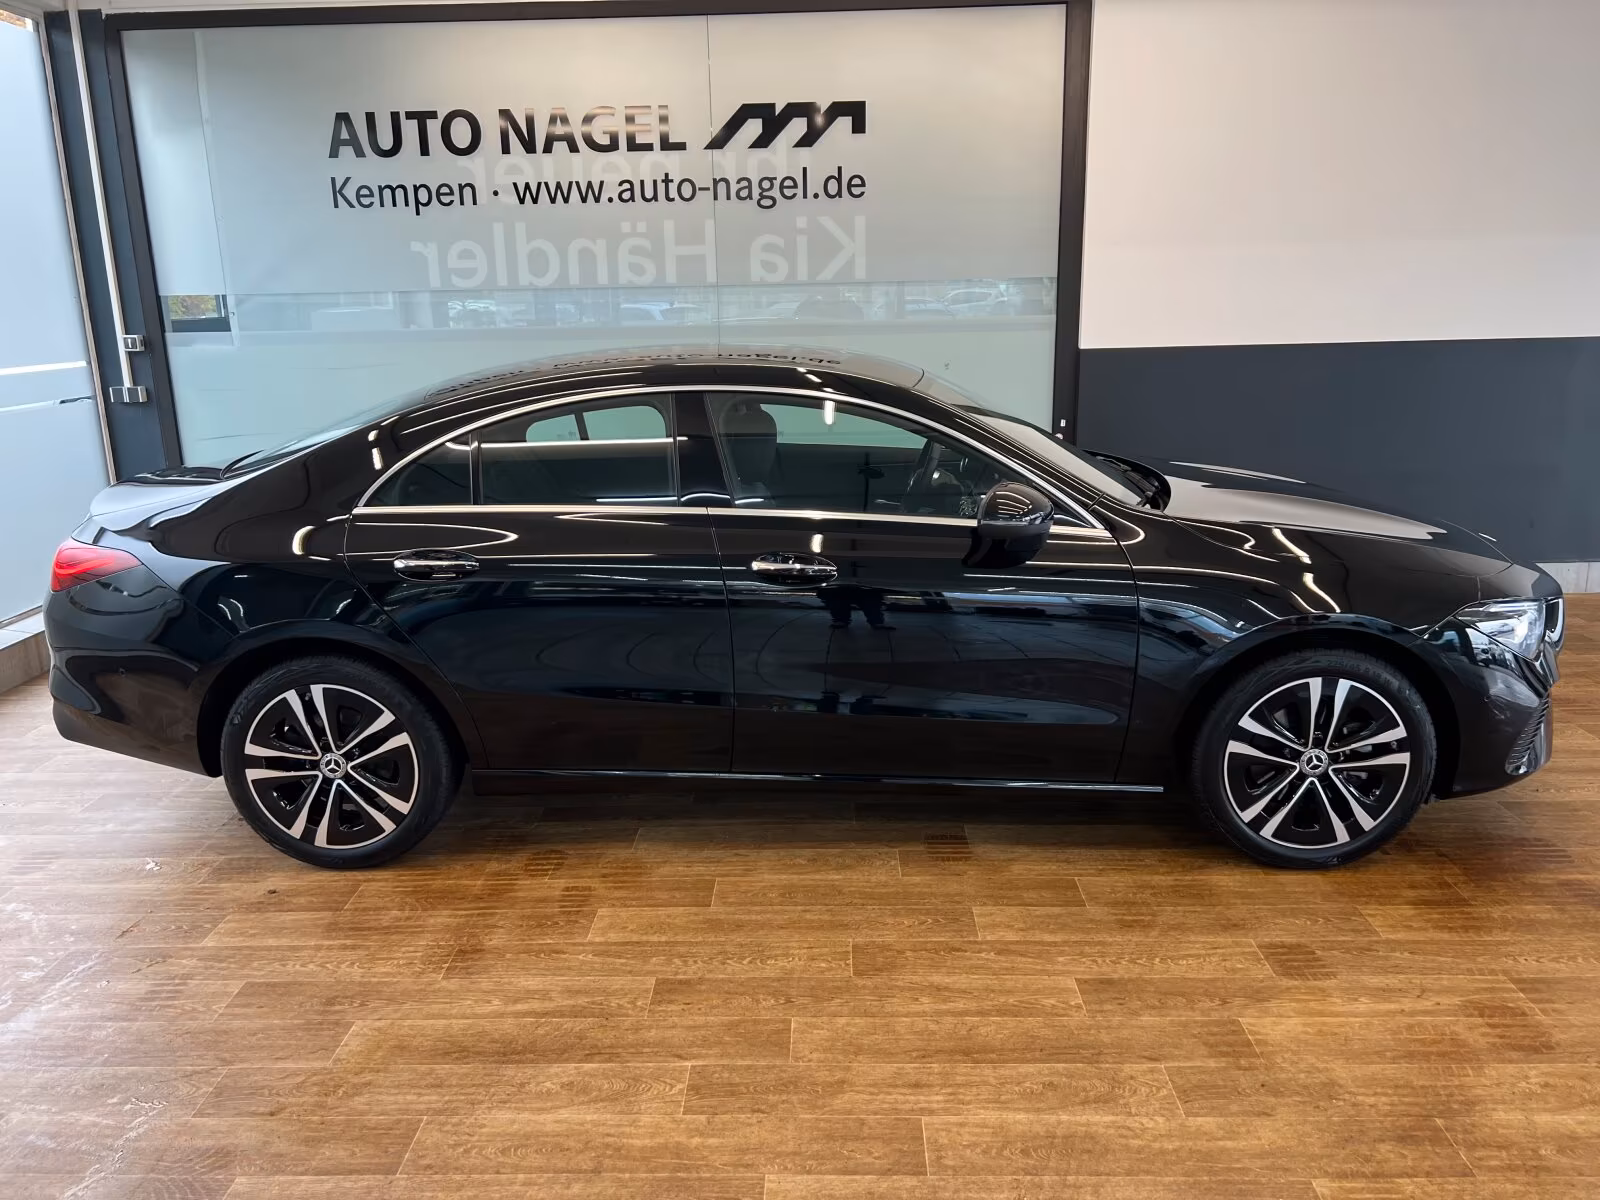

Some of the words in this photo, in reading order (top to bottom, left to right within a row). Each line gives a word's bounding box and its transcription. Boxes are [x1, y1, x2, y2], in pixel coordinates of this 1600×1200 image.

[328, 108, 482, 158] AUTO
[498, 104, 687, 155] NAGEL
[330, 176, 478, 216] Kempen
[512, 165, 867, 210] www.auto-nagel.de
